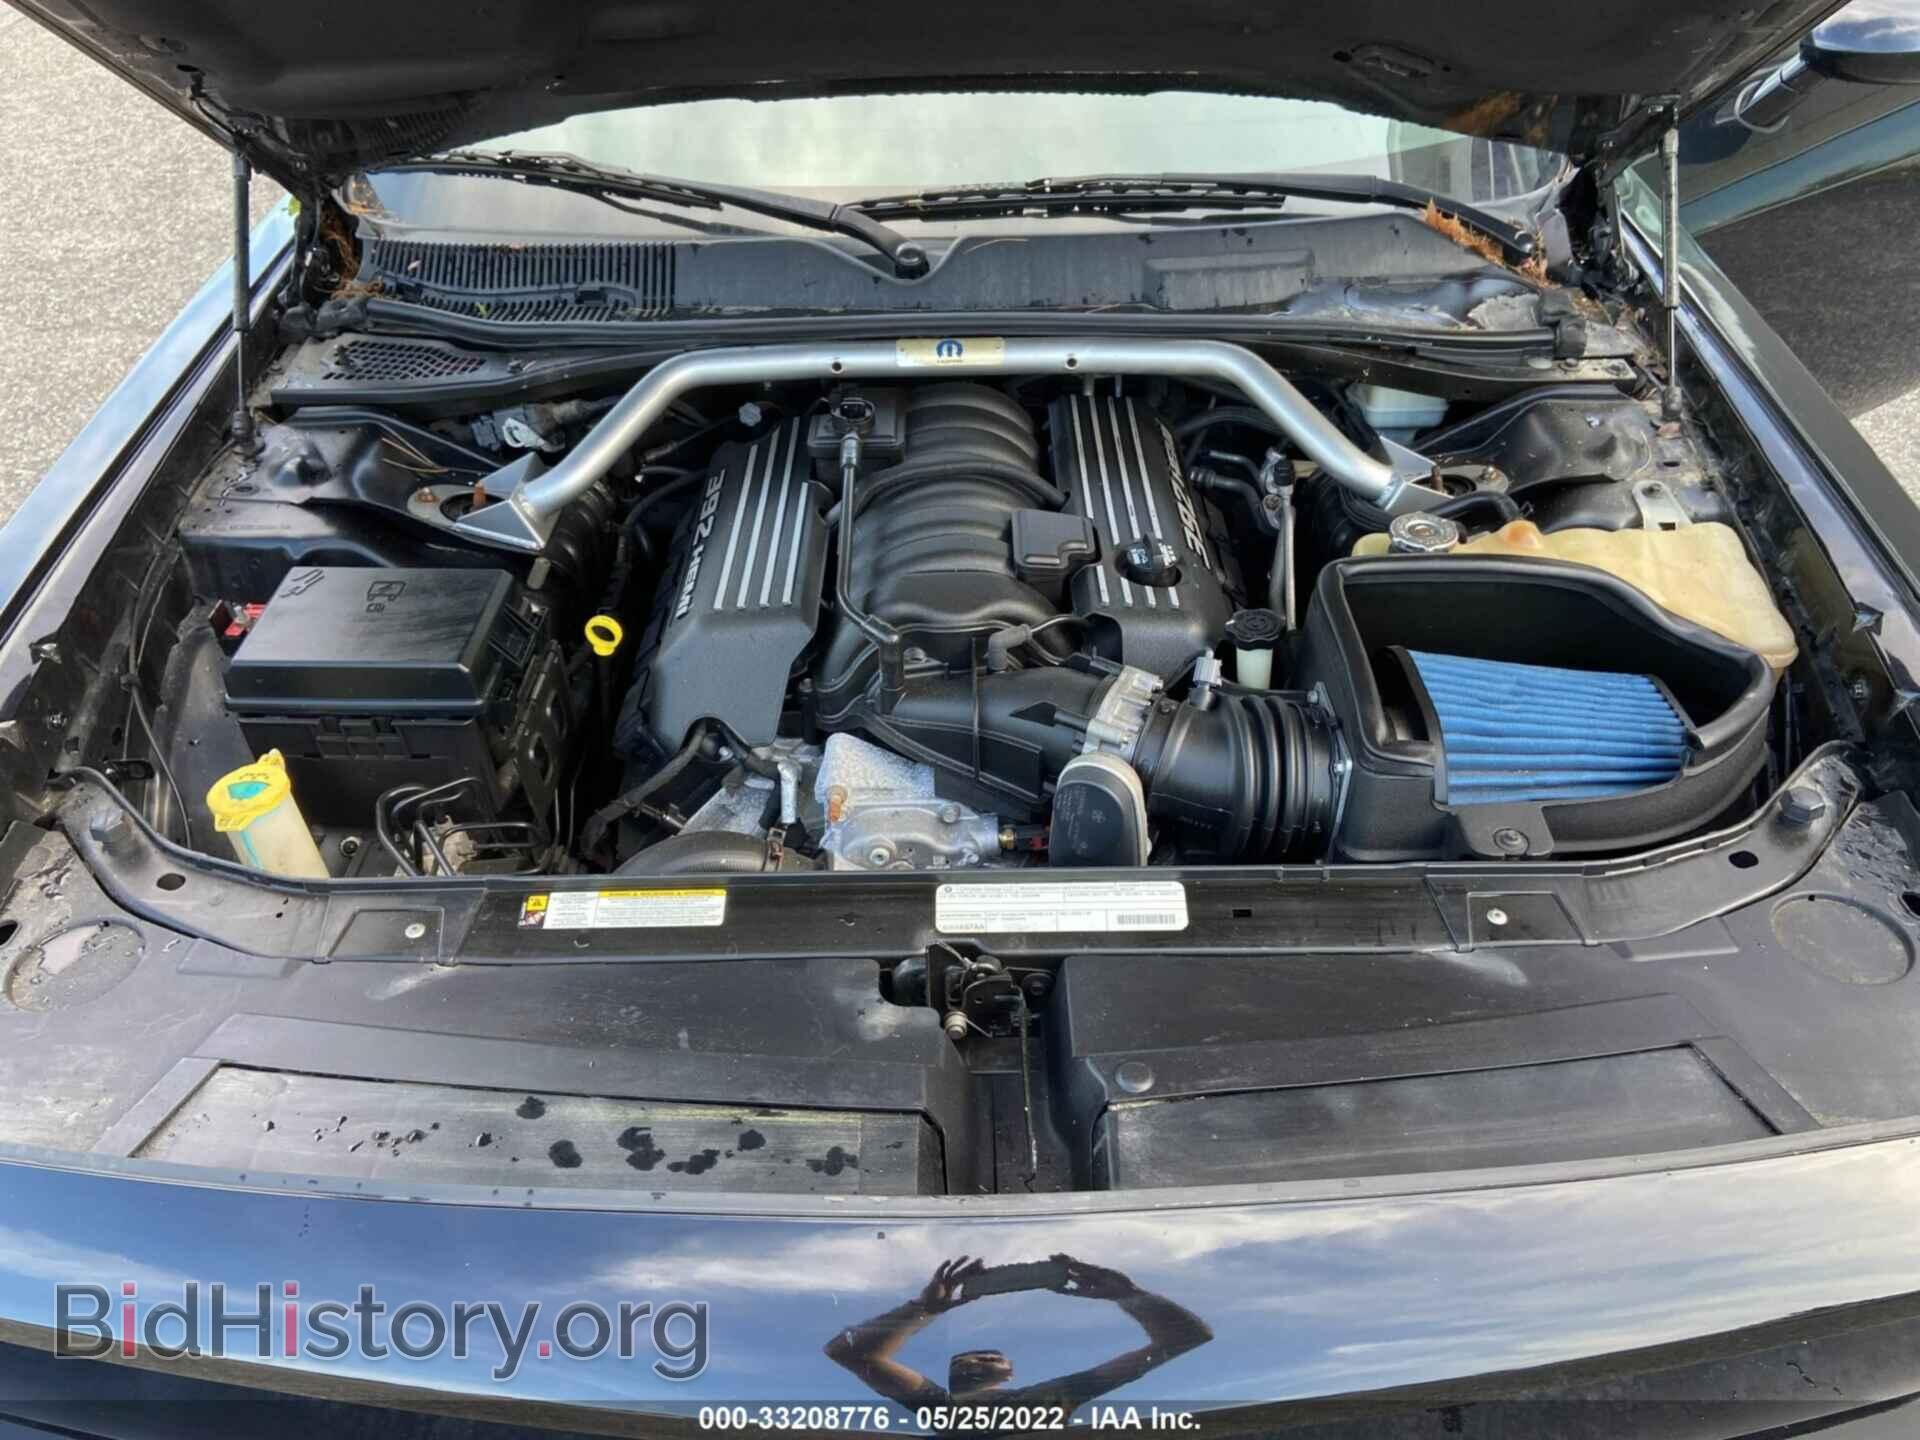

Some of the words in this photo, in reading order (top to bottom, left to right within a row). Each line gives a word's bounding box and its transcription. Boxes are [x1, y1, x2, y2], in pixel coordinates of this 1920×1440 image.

[692, 468, 726, 546] 392
[1171, 479, 1211, 570] 392
[675, 543, 704, 620] HEMI
